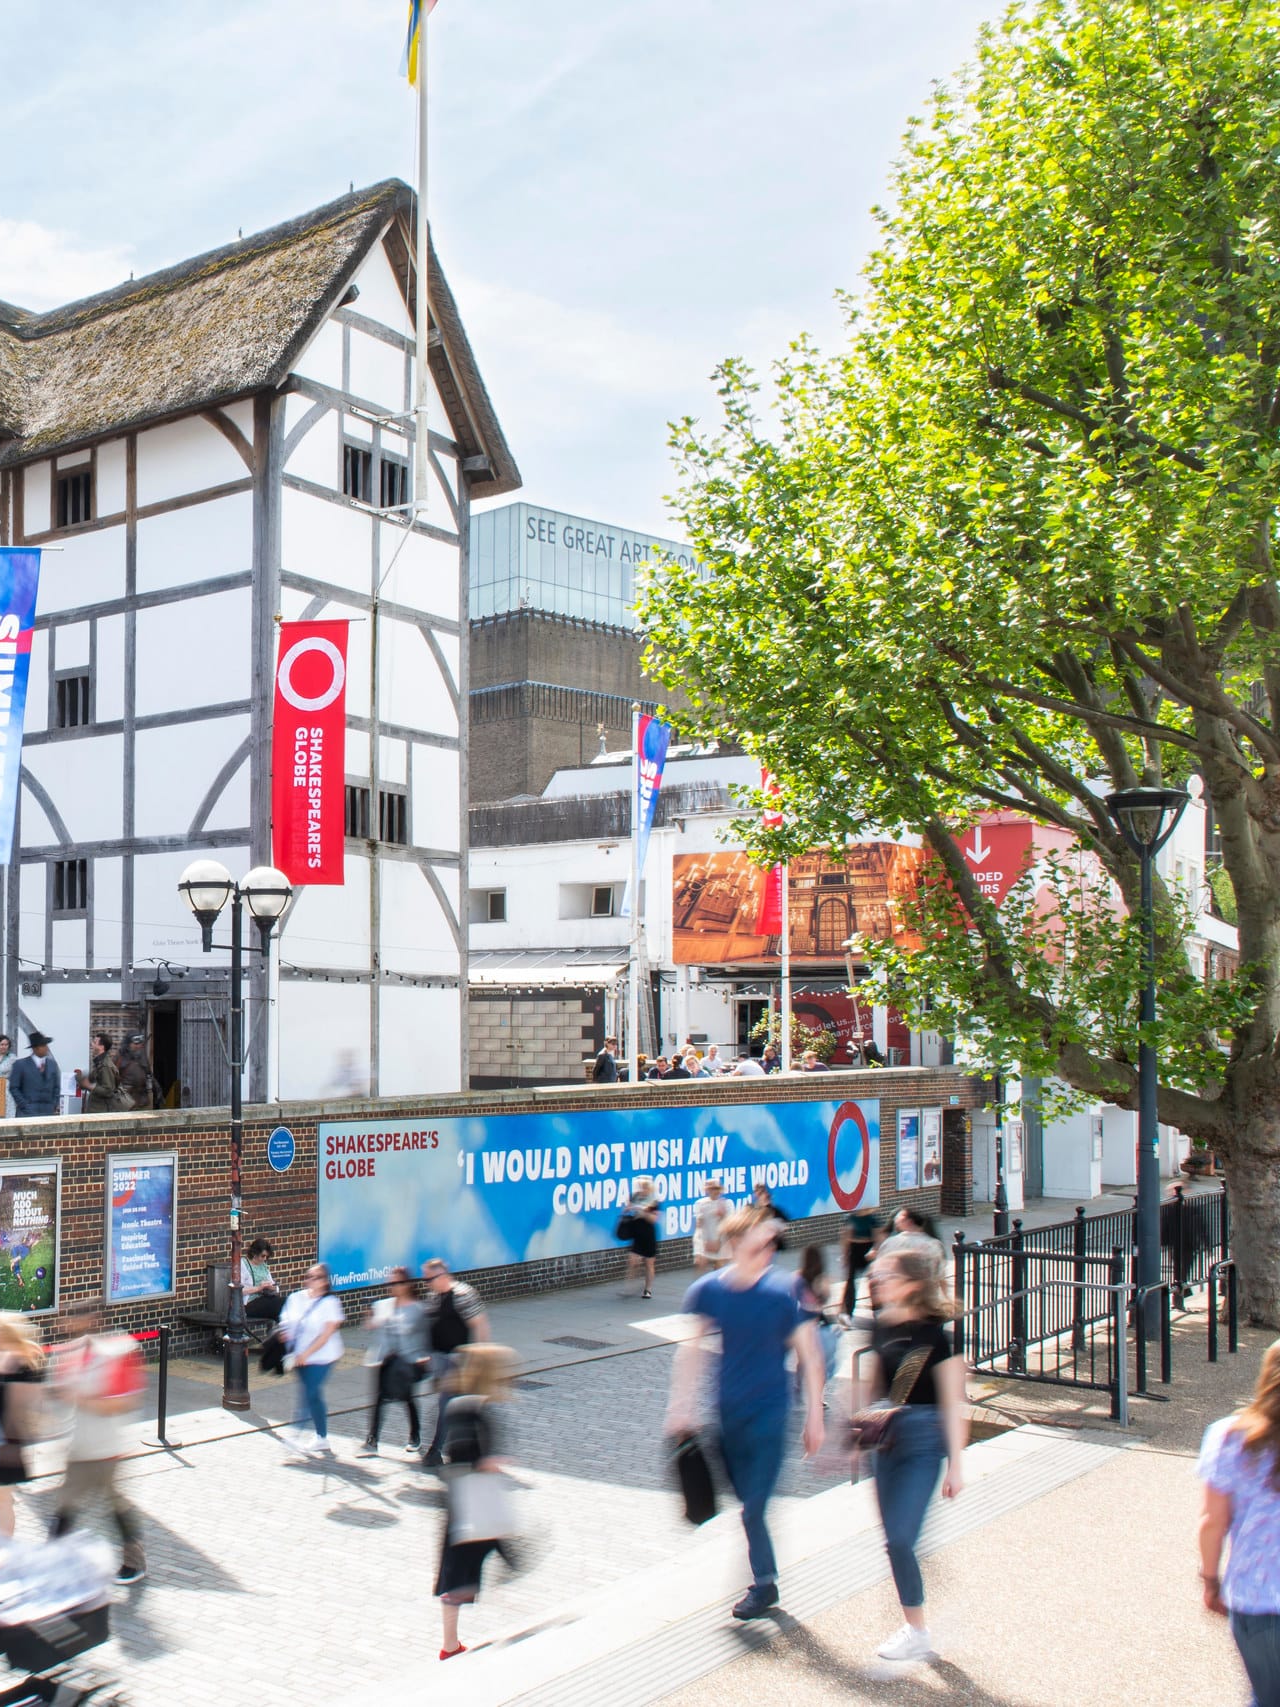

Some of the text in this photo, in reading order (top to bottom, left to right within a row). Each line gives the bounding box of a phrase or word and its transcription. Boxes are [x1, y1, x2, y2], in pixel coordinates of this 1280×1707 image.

[526, 516, 556, 544] SEE
[563, 525, 615, 559] GREAT
[620, 540, 650, 562] ART
[293, 727, 308, 787] GLOBE
[307, 727, 323, 869] SHAKESPEARE'S
[326, 1131, 439, 1156] SHAKESPEARE'S
[482, 1146, 572, 1184] WOULD
[579, 1143, 625, 1175] NOT
[630, 1138, 683, 1170] WISH
[688, 1135, 728, 1166] ANY
[325, 1158, 376, 1180] GLOBE
[113, 1170, 151, 1181] SUMMER
[113, 1181, 136, 1192] 2022
[553, 1159, 809, 1216] COMPAON IN THE WORLD
[13, 1191, 38, 1201] MUCH
[13, 1200, 32, 1209] ADO
[13, 1207, 43, 1217] ABOUT
[13, 1215, 49, 1226] NOTHING
[122, 1219, 162, 1229] Iconic Theatre
[121, 1232, 148, 1242] Inspiring
[121, 1241, 151, 1250] Education
[122, 1252, 156, 1263] Fascinating
[122, 1261, 160, 1271] Guided Tours
